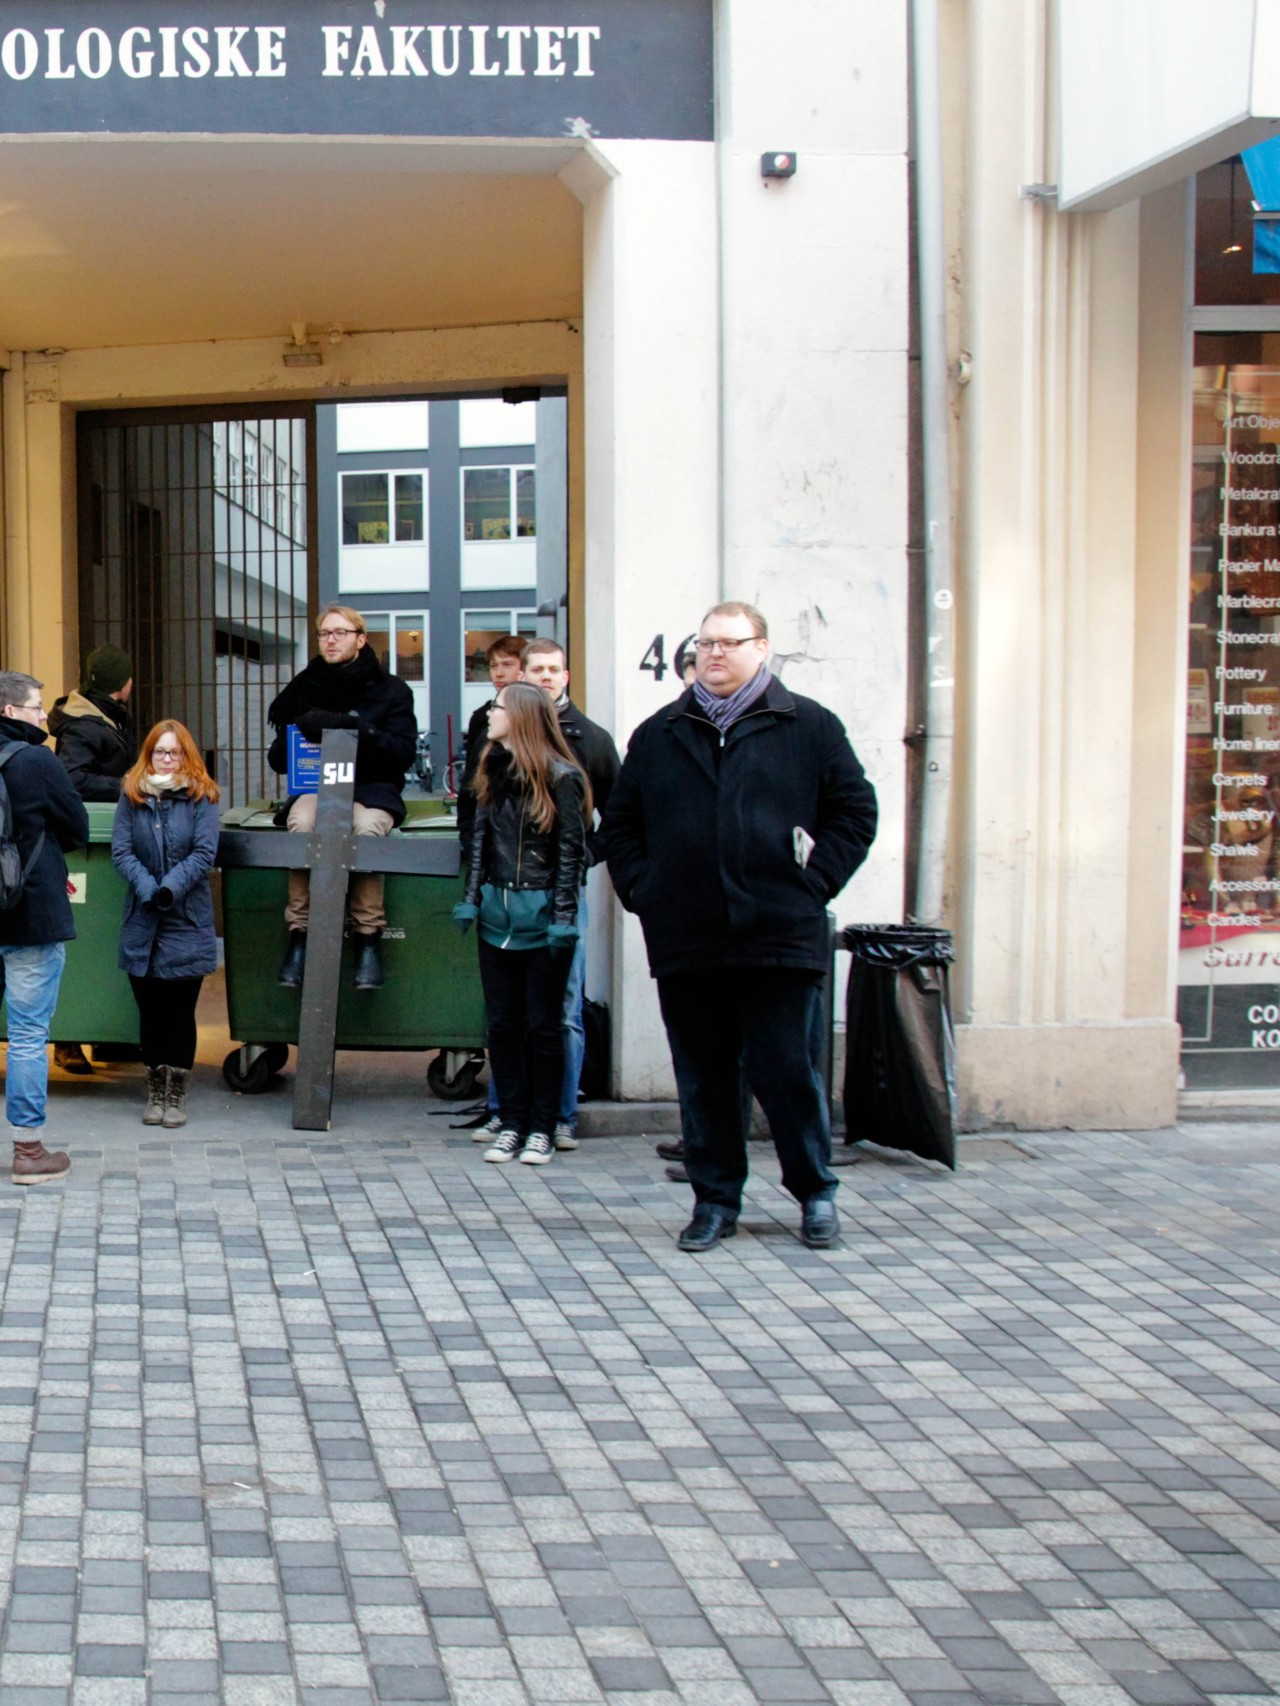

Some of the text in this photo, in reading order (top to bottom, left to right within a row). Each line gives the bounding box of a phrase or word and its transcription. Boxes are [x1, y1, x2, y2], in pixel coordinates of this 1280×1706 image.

[321, 25, 601, 77] FAKULTET
[1220, 487, 1280, 500] Metalcra
[1218, 522, 1276, 536] Bankura
[1218, 558, 1262, 574] Papier
[1215, 665, 1267, 682] Pottery
[1214, 701, 1273, 716] Furniture
[1213, 736, 1253, 751] Home
[323, 762, 354, 785] SU
[1211, 772, 1268, 787] Carpets
[1210, 807, 1275, 822] Jewellery
[1209, 842, 1259, 857] Shawls
[1207, 912, 1261, 927] Candles
[1247, 1004, 1280, 1024] CO
